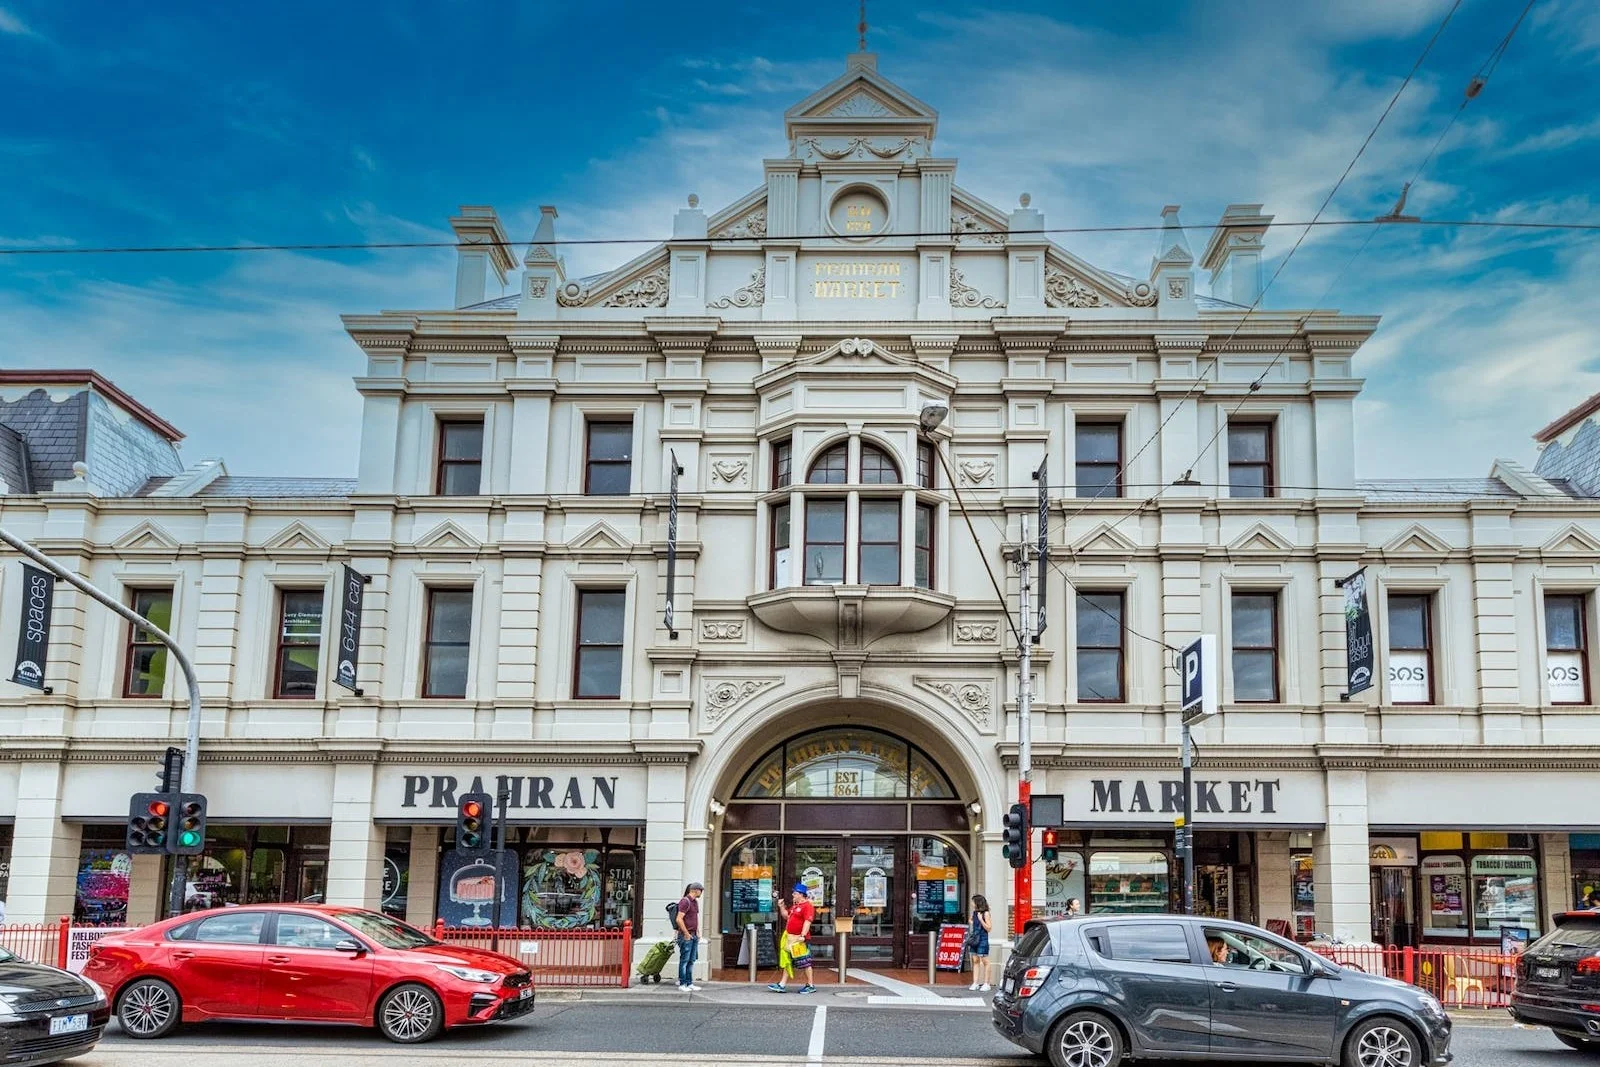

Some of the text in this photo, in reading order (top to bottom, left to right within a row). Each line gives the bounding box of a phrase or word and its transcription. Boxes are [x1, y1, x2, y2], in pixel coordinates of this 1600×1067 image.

[814, 281, 901, 298] MARKET
[348, 573, 360, 605] car
[27, 575, 47, 643] spaces
[342, 609, 357, 652] 644
[1185, 651, 1198, 698] P
[835, 772, 859, 783] EST
[834, 784, 859, 796] 1864
[1090, 778, 1280, 813] MARKET
[1476, 861, 1500, 869] TOBACCO
[1505, 861, 1532, 869] CIGARETTE
[610, 869, 631, 879] STIR
[615, 880, 627, 889] THE
[610, 890, 629, 900] POT
[939, 952, 960, 962] $9.50
